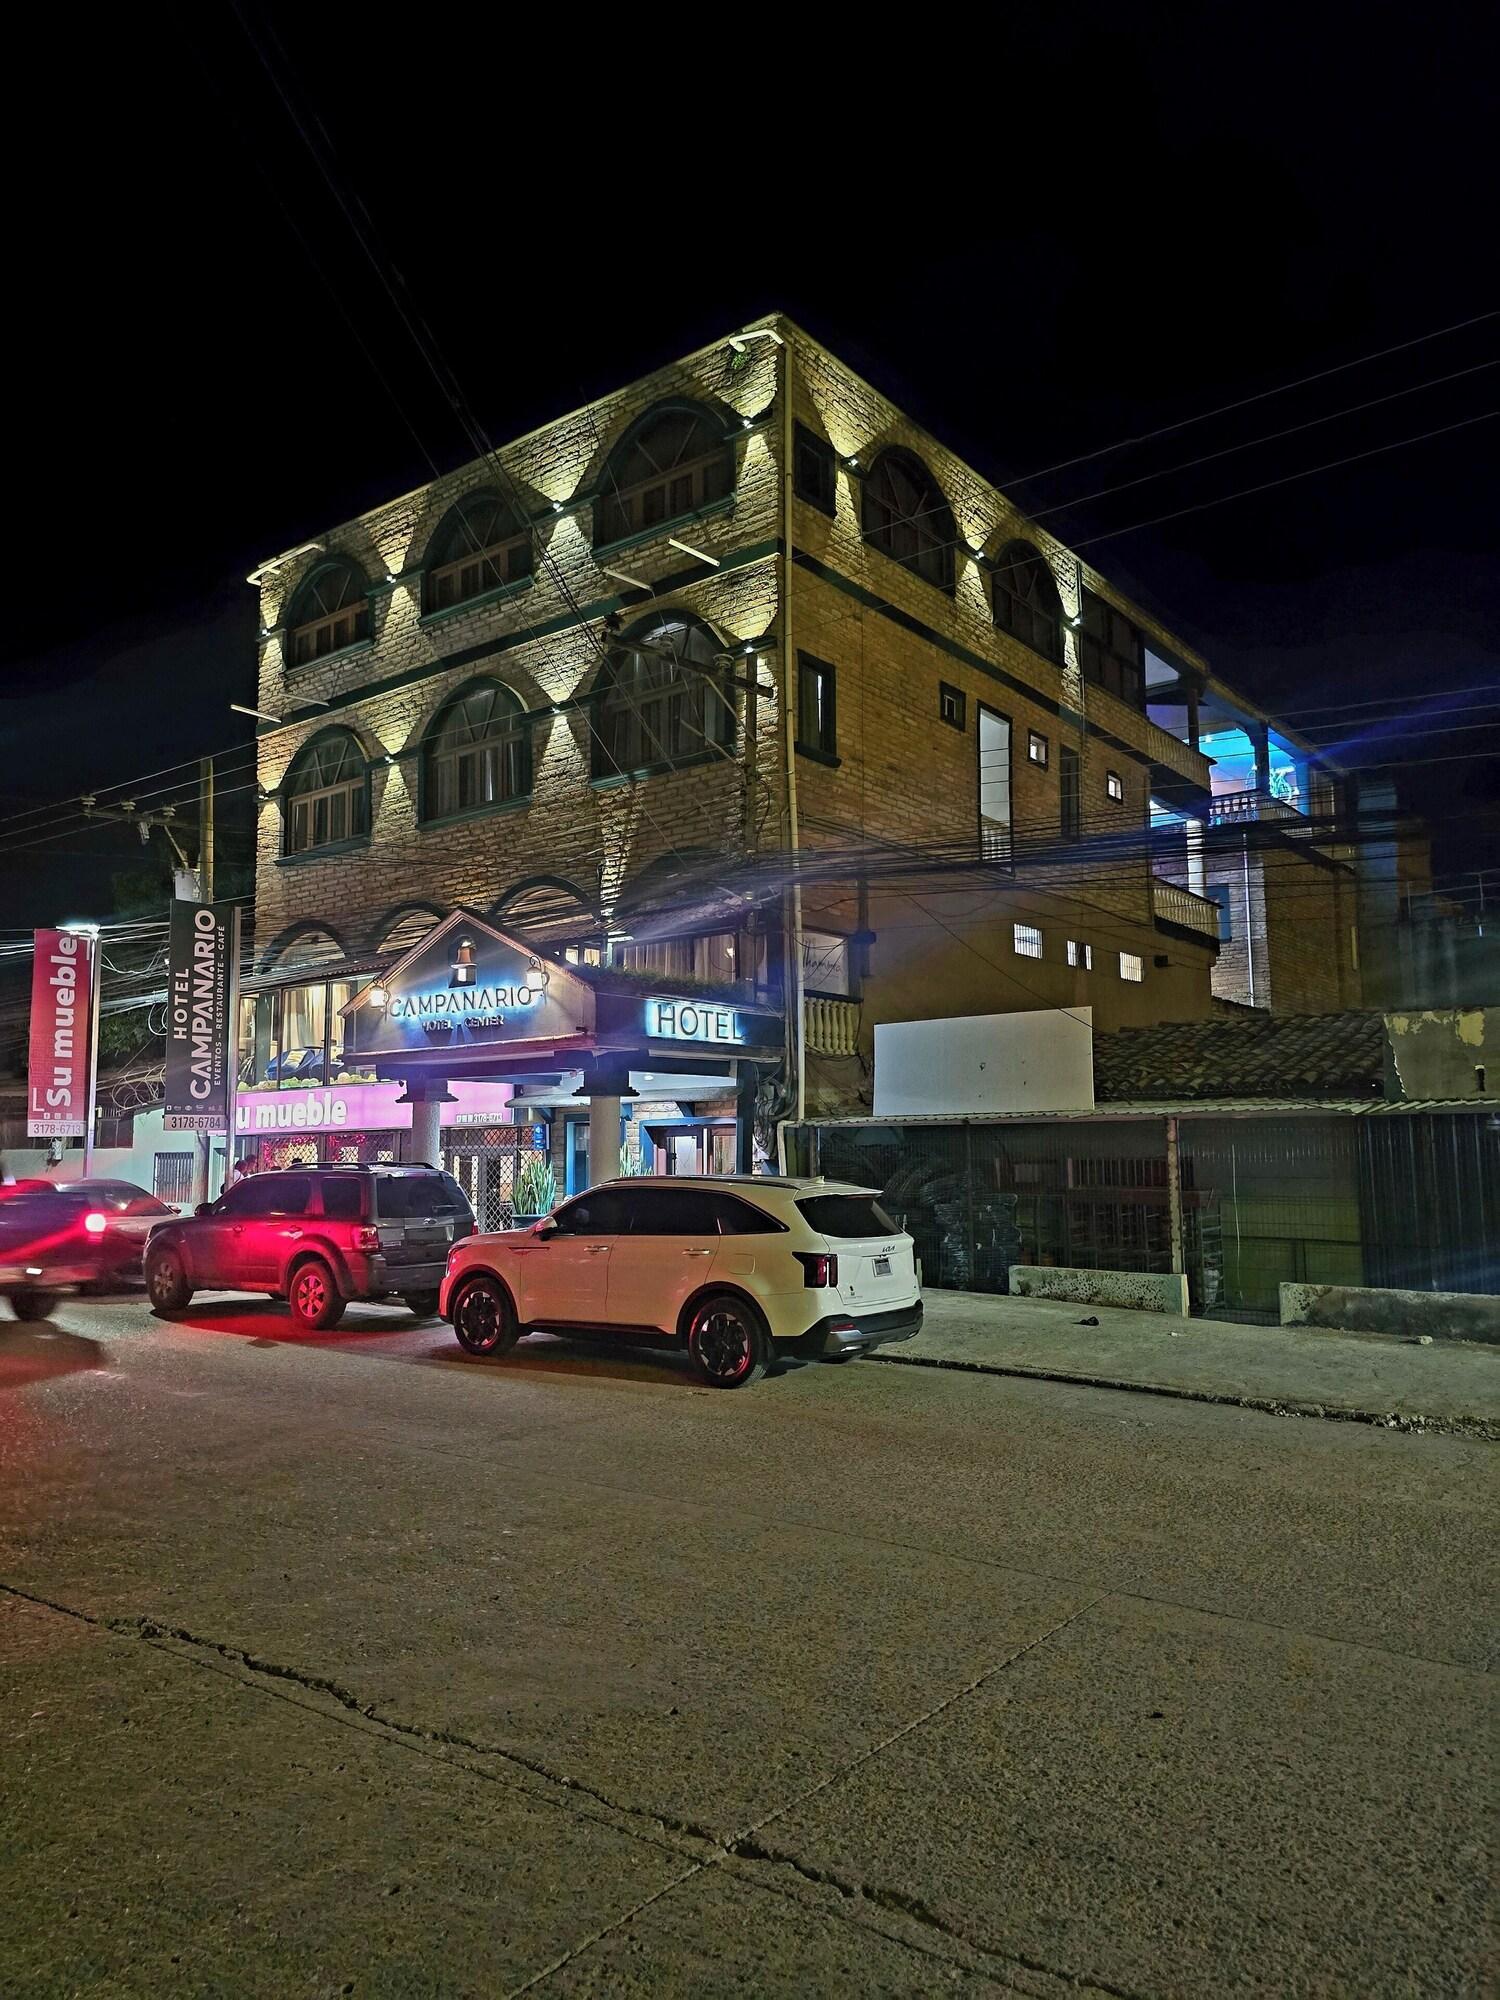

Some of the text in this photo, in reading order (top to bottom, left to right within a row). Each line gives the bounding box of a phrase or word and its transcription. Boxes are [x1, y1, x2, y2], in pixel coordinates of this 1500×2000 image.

[217, 925, 226, 951] CAFÉ
[173, 967, 190, 1040] HOTEL
[190, 909, 216, 1100] CAMPANARIO
[215, 962, 224, 1031] RESTAURANTE
[390, 985, 531, 1017] CAMPANARIO
[46, 936, 79, 1107] Su mueble
[464, 1014, 505, 1028] CENTER
[656, 1004, 744, 1041] HOTEL
[214, 1042, 222, 1086] EVENTOS
[33, 1123, 81, 1135] 3178-6713
[171, 1116, 221, 1129] 3178-6784
[237, 1092, 347, 1130] u mueble
